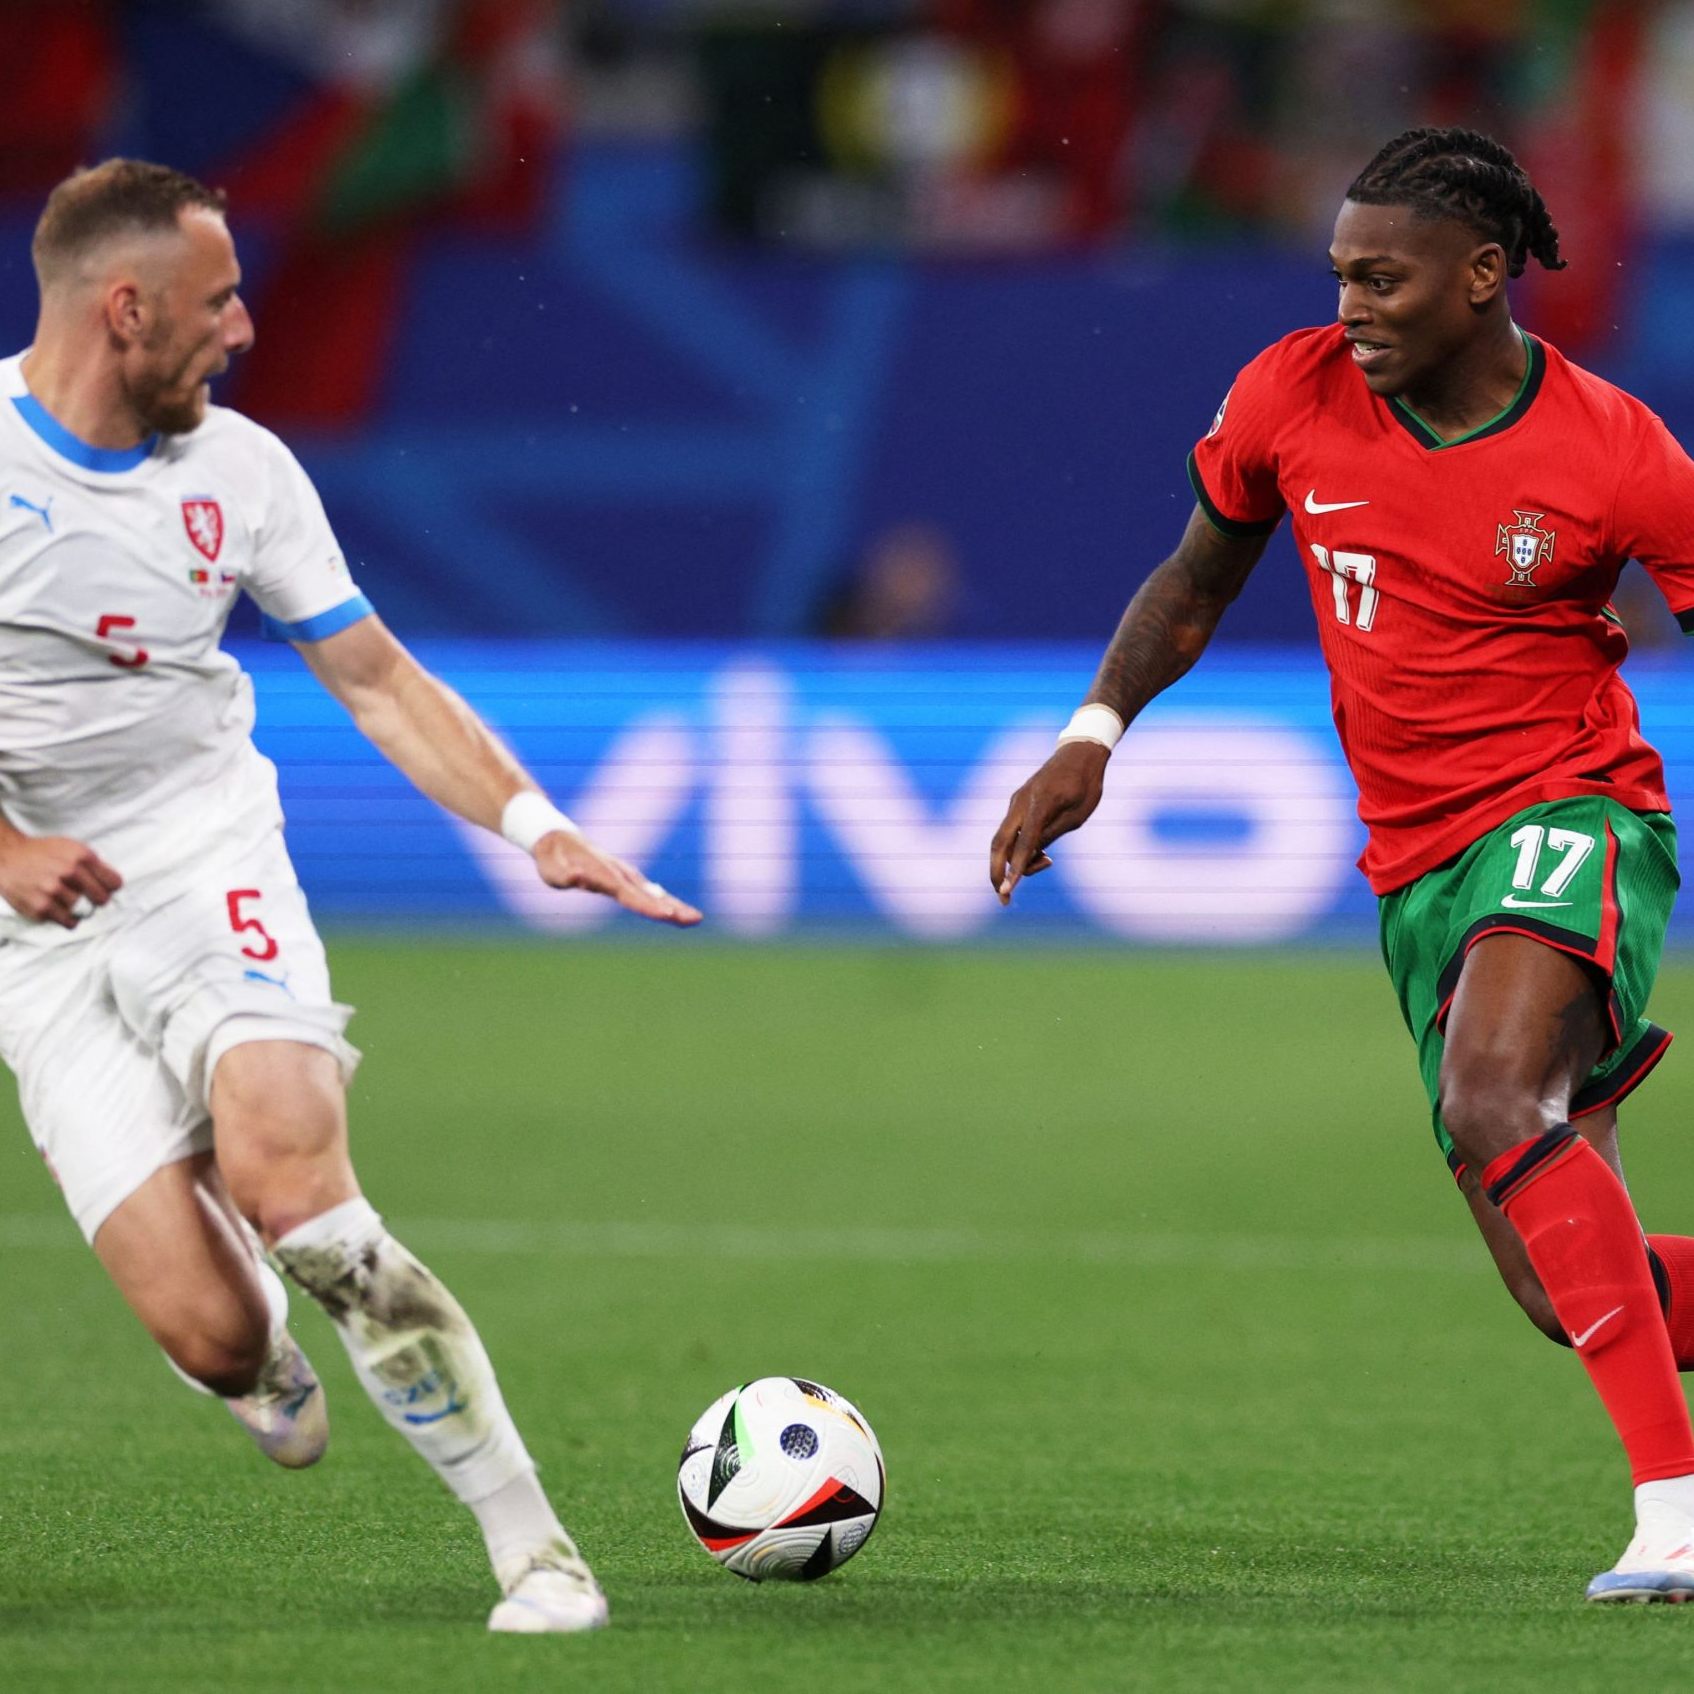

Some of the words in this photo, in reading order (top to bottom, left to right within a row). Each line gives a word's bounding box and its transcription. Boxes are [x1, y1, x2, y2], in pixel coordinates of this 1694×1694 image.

[1310, 543, 1379, 632] 17
[97, 614, 148, 669] 5
[450, 658, 1352, 943] vivo
[1510, 825, 1595, 897] 17
[226, 889, 278, 962] 5
